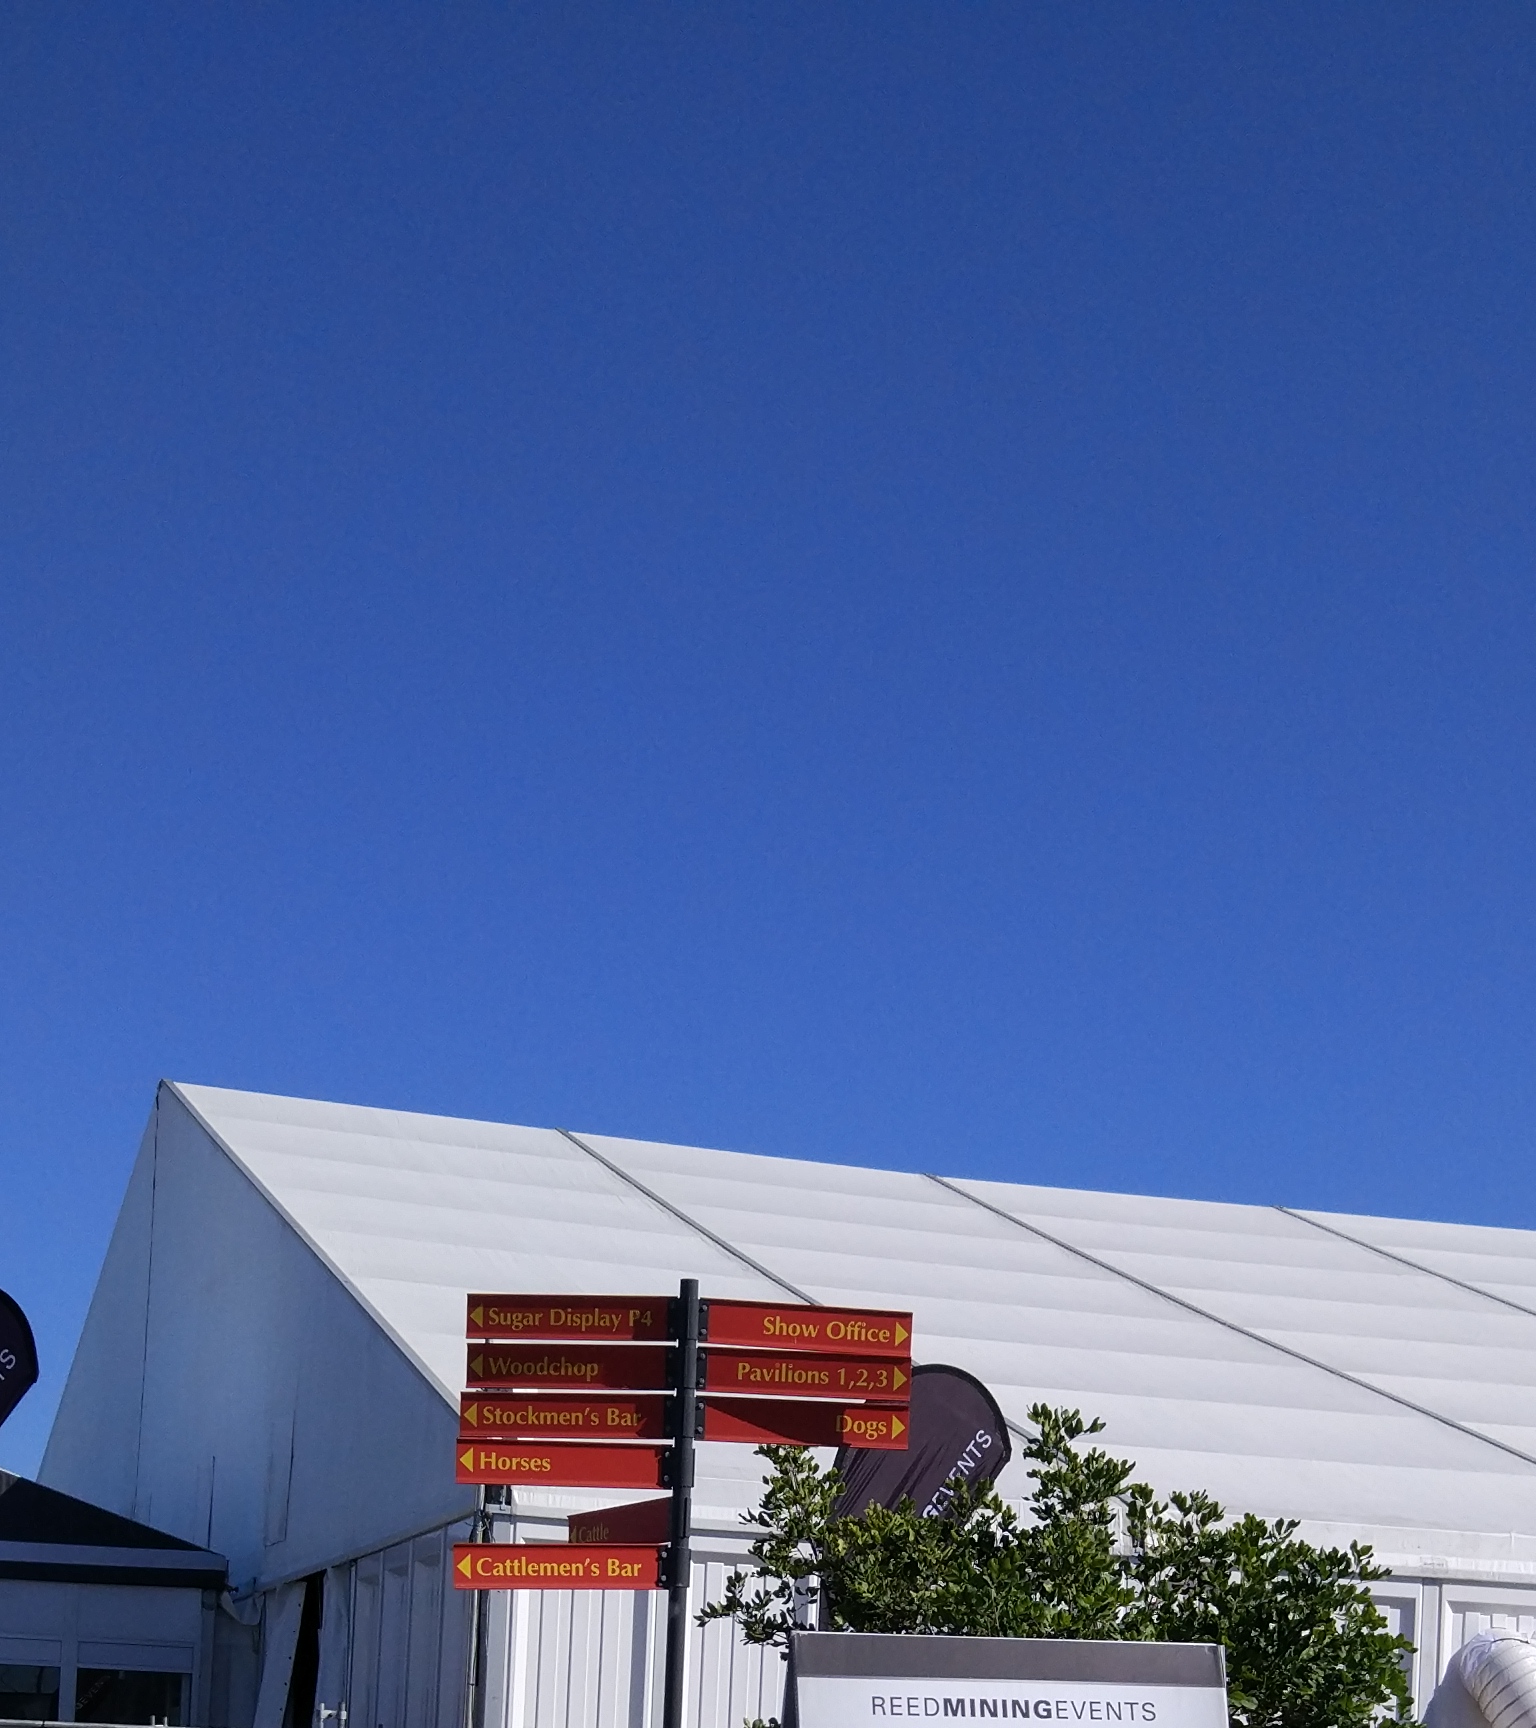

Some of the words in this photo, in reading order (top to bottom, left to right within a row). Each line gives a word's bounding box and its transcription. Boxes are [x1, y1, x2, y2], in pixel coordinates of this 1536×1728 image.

[488, 1307, 543, 1331] Sugar
[549, 1307, 622, 1332] Display
[628, 1309, 654, 1327] P4
[762, 1315, 820, 1338] Show
[826, 1321, 890, 1343] Office
[489, 1356, 599, 1382] Woodchop
[737, 1362, 829, 1385] Pavilions
[837, 1367, 888, 1391] 1,2,3
[482, 1405, 600, 1426] Stockmen's
[607, 1407, 642, 1427] Bar
[835, 1414, 887, 1440] Dogs
[479, 1451, 552, 1472] Horses
[476, 1556, 601, 1577] Cattlemen's
[607, 1557, 642, 1577] Bar
[871, 1695, 1157, 1722] REEDMININGEVENTS
